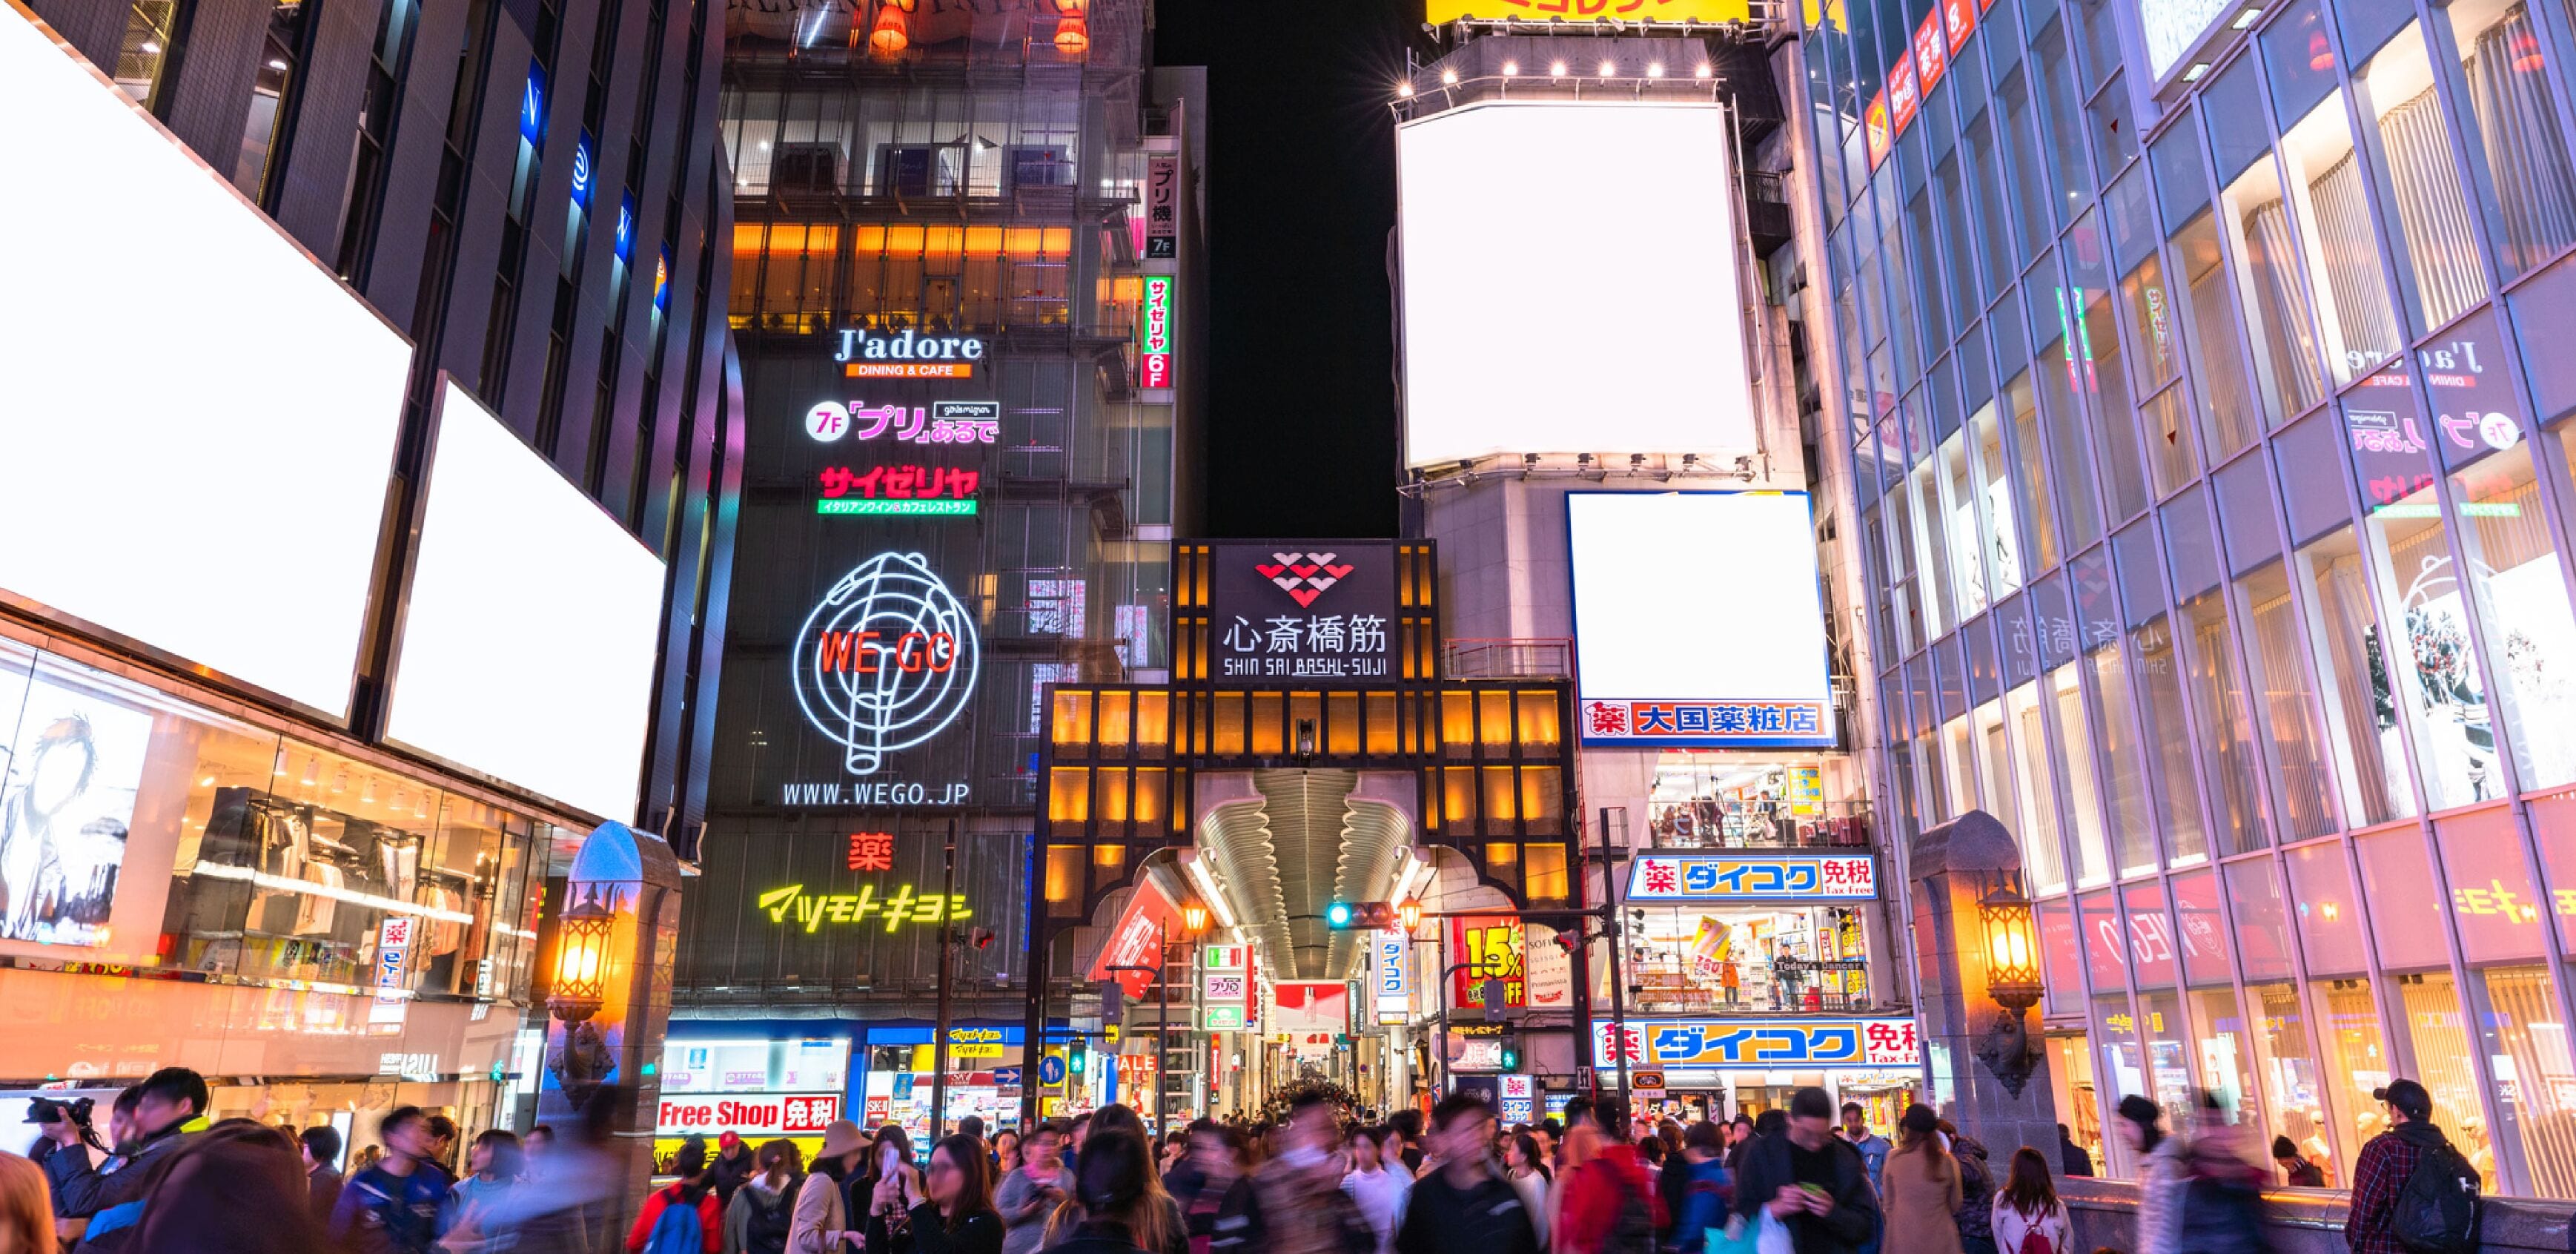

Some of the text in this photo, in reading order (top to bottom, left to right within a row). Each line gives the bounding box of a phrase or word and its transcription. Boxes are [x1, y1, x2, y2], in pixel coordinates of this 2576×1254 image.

[1153, 169, 1173, 222] プリ機
[1153, 239, 1171, 252] 7F
[1150, 281, 1165, 349] サイゼリヤ
[834, 329, 982, 361] J'adore
[858, 365, 954, 376] DINING & CAFE
[816, 411, 842, 434] 7F
[820, 465, 979, 499] サイゼリヤ
[1222, 614, 1388, 653] 心斎橋筋
[1224, 658, 1259, 676] SHIN
[1265, 658, 1290, 676] SAI
[1592, 702, 1818, 733] 薬 大国薬粧店
[784, 783, 970, 805] WWW.WEGO.JP
[847, 831, 893, 871] 薬
[1644, 859, 1872, 894] 薬 ダイコク 免税
[1826, 885, 1873, 895] Tax-Free
[759, 883, 973, 934] マツモトキヨシ
[1384, 943, 1401, 991] ダイコク
[1503, 981, 1523, 1005] FF
[1654, 1027, 1858, 1061] ダイコク
[1868, 1053, 1918, 1063] Tax-Fr
[1507, 1077, 1526, 1096] 薬
[659, 1099, 835, 1128] Free Shop 免税
[867, 1100, 888, 1112] SK-II
